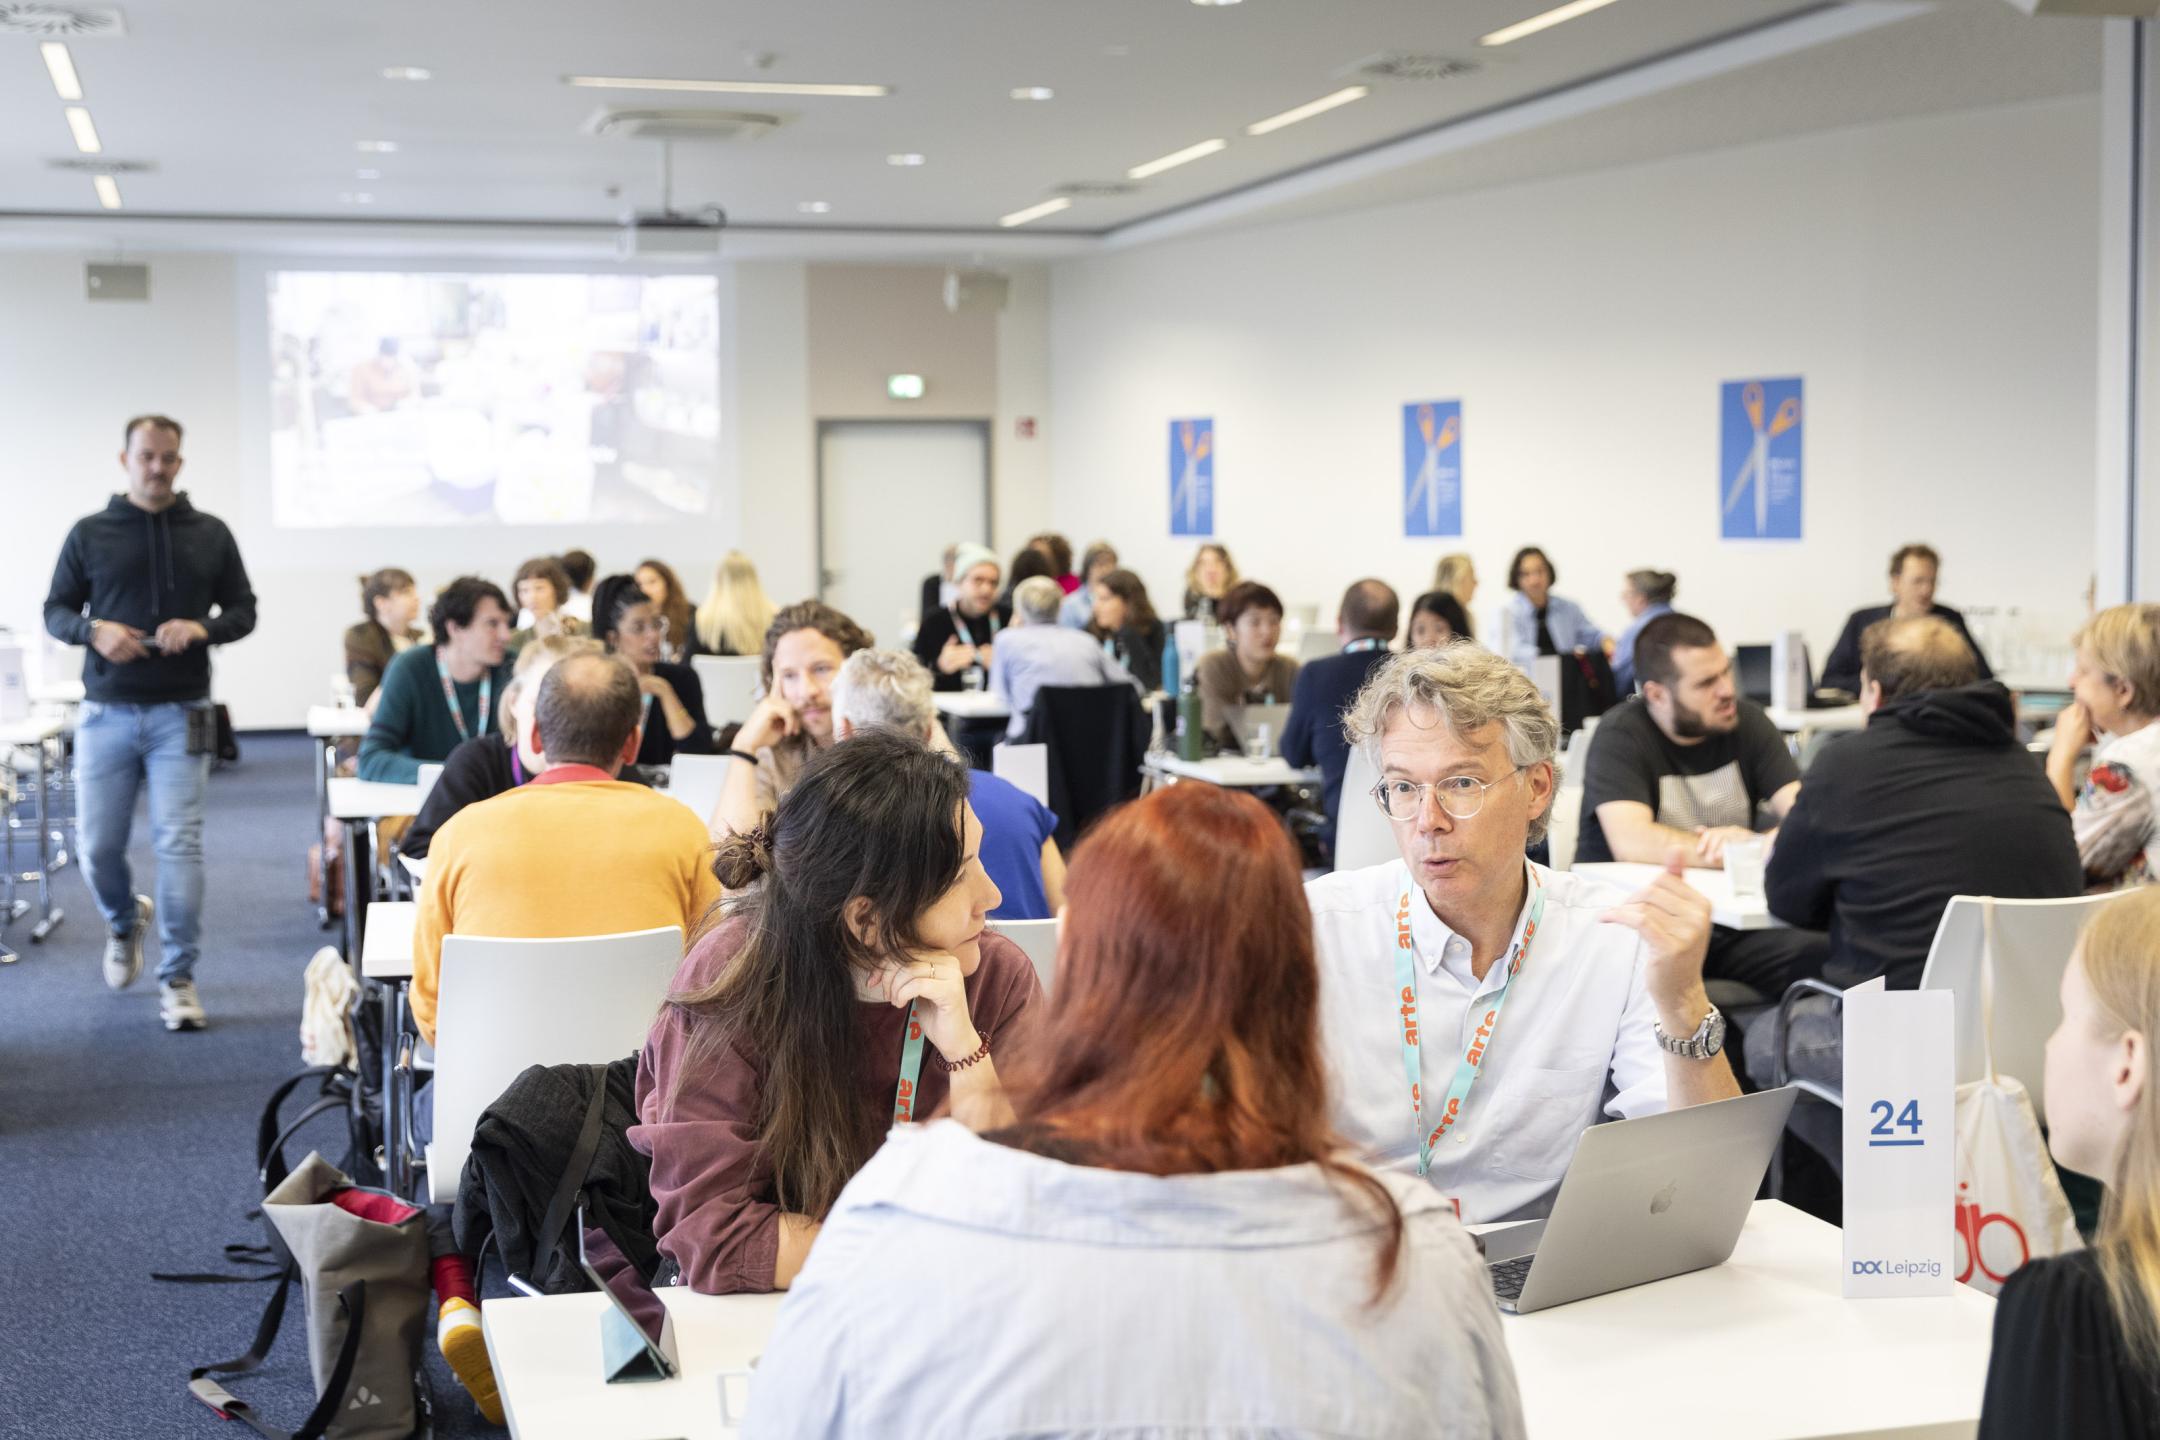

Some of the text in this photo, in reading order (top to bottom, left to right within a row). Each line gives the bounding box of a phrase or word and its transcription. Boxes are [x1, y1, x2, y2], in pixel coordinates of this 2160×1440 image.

[1396, 892, 1411, 950] arte
[1401, 986, 1418, 1047] arte
[1466, 1009, 1496, 1067] arte
[895, 1078, 913, 1122] art
[1428, 1097, 1460, 1148] arte
[1871, 1099, 1924, 1135] 24
[1886, 1259, 1941, 1278] Leipzig
